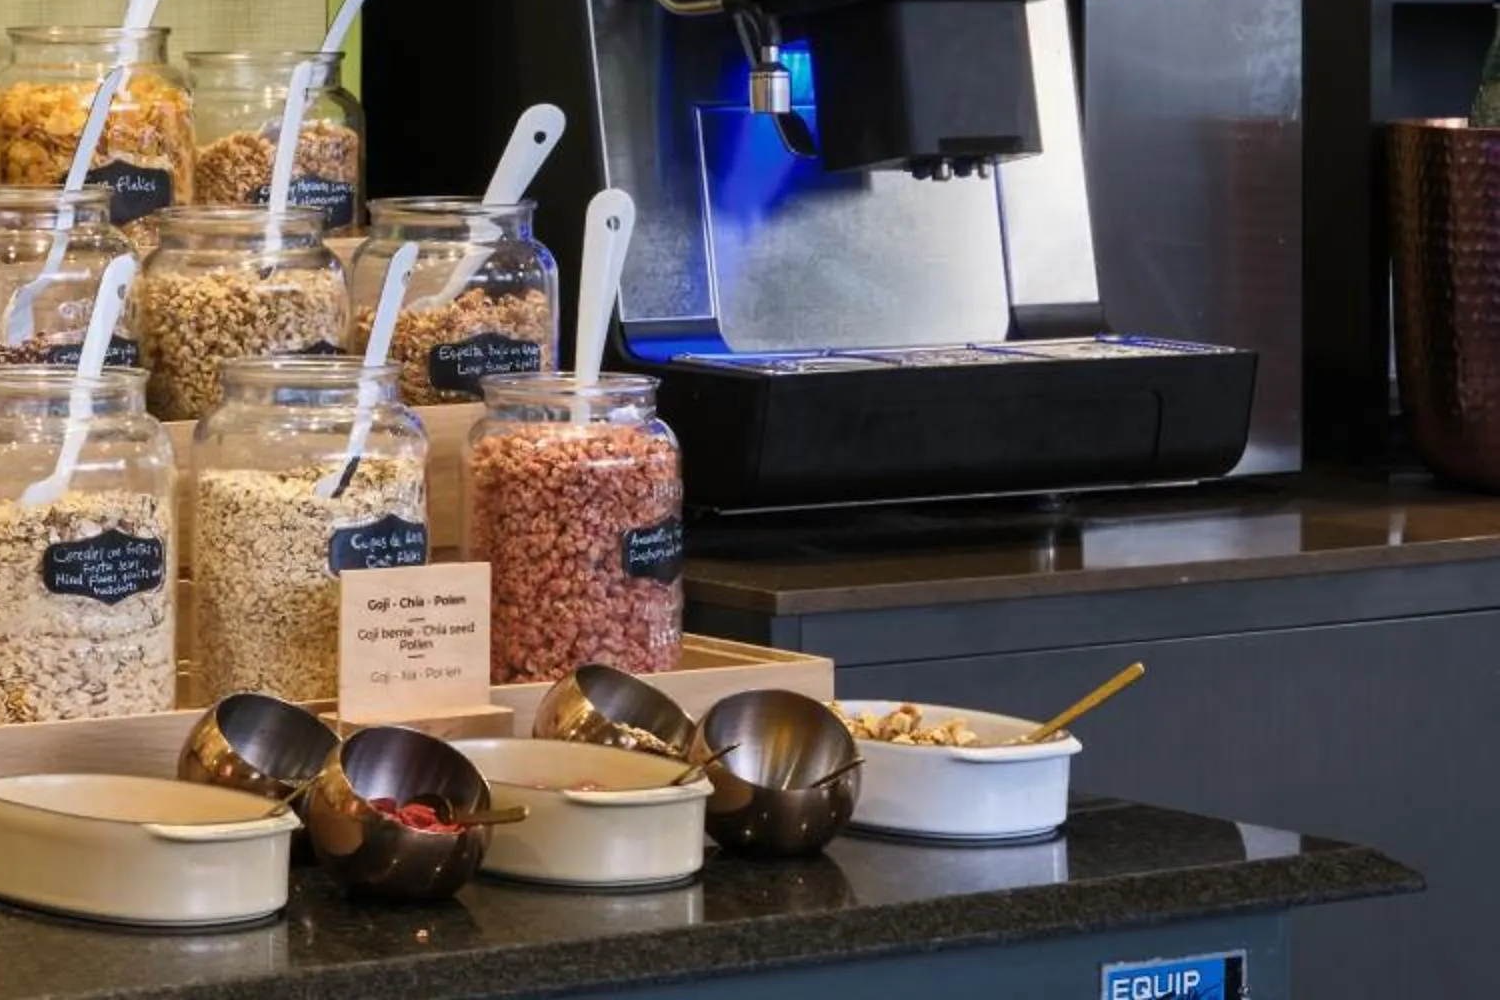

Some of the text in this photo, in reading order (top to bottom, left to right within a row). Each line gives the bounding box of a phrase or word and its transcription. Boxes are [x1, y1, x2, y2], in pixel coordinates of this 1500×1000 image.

[367, 597, 391, 612] Goji
[357, 628, 379, 642] Goji
[449, 621, 475, 635] seed
[1112, 969, 1201, 1000] EQUIP
